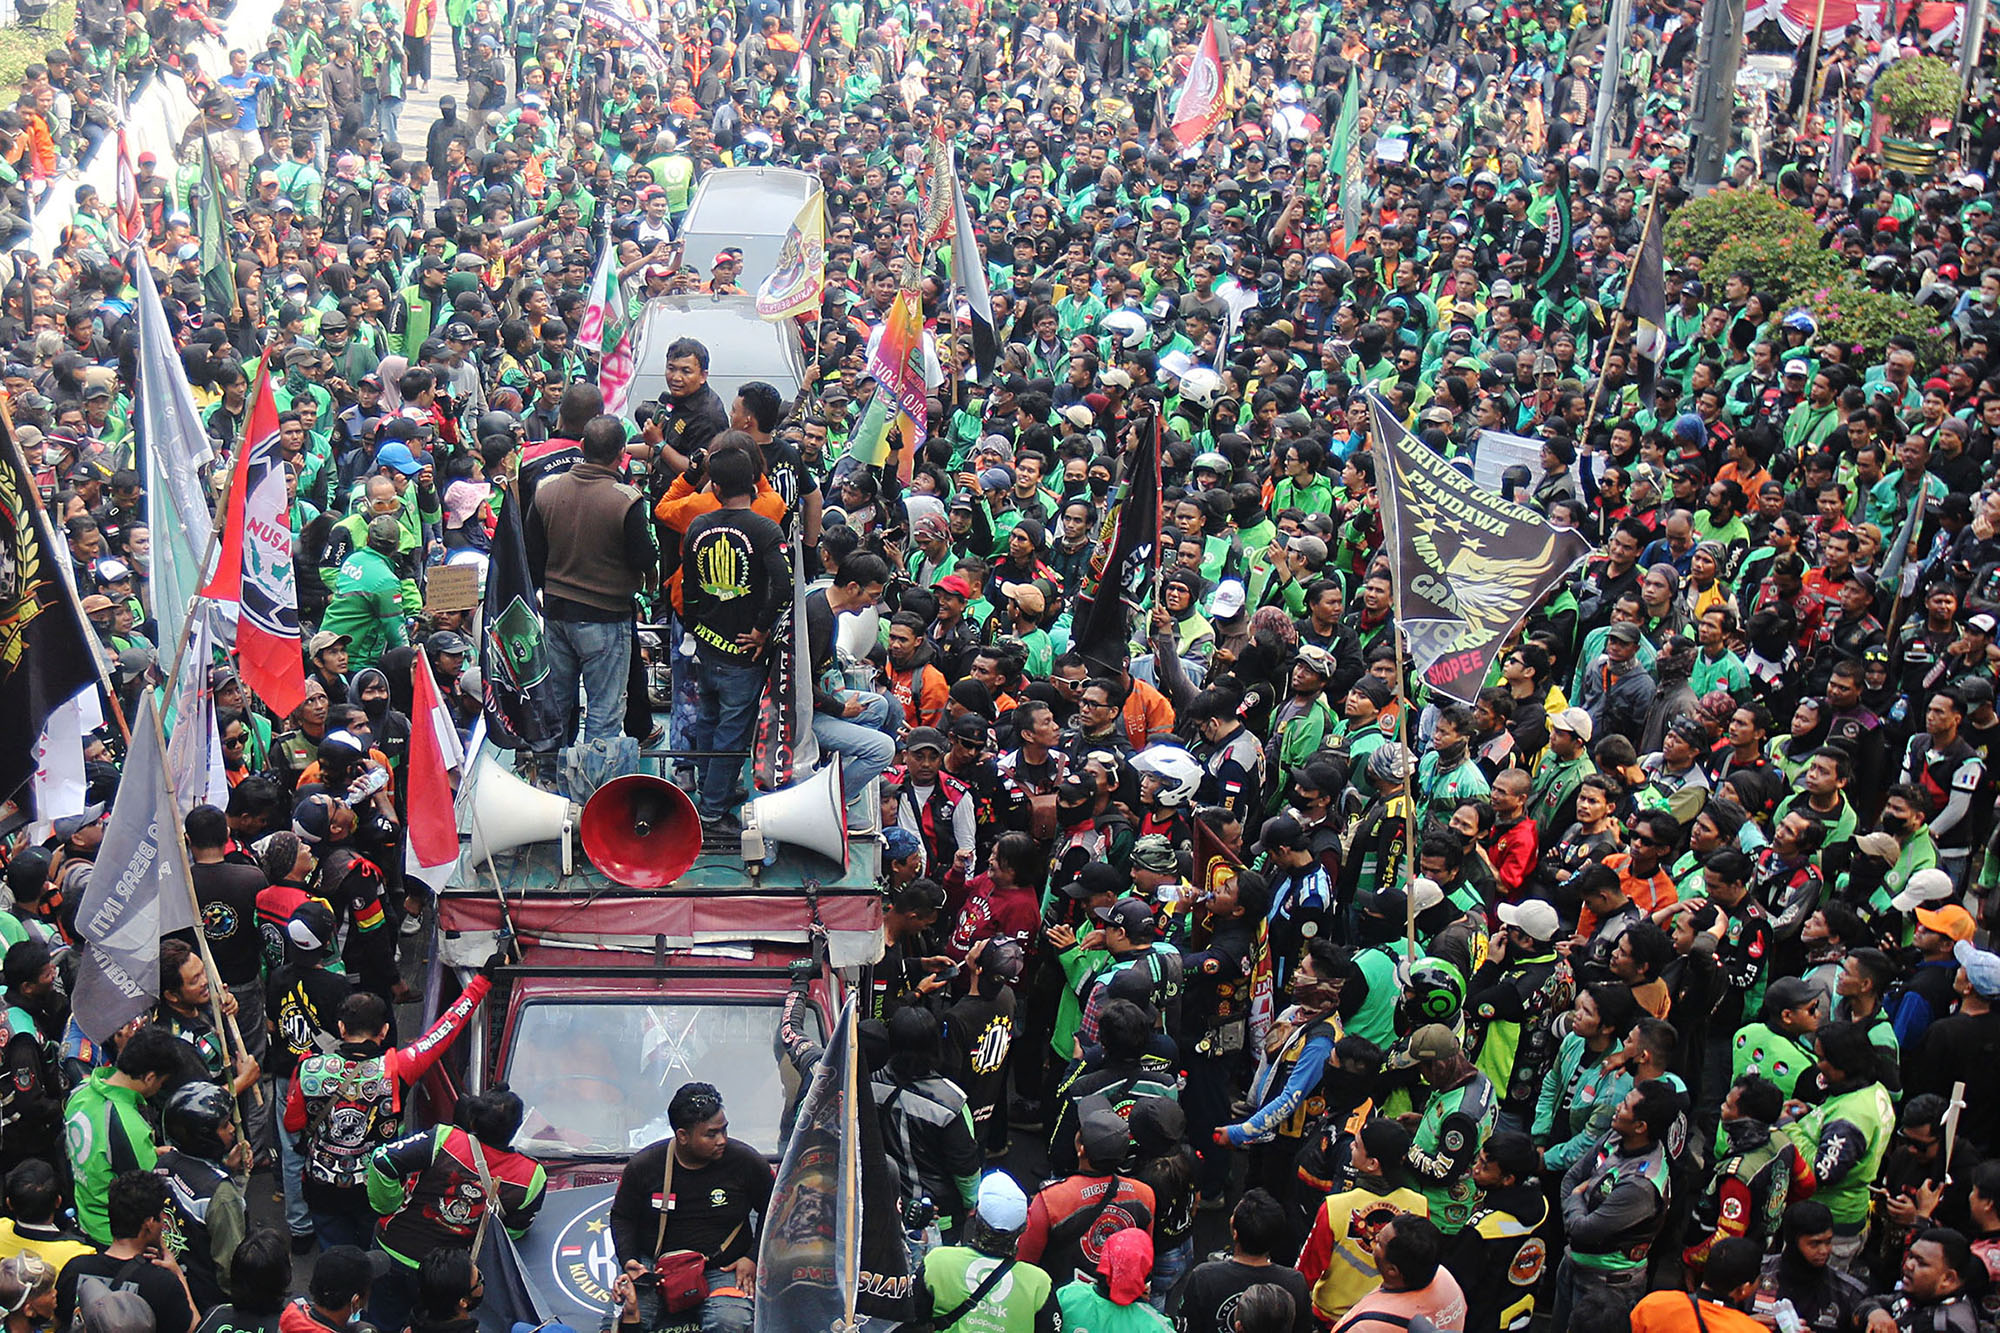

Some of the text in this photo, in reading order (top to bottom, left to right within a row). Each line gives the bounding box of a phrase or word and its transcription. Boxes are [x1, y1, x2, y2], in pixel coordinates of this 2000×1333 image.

[1397, 434, 1473, 494] DRIVER
[1470, 490, 1541, 526] ONLINE
[1406, 470, 1510, 537] PANDAWA
[246, 517, 294, 558] NUSA
[694, 623, 747, 655] PATRIO
[1428, 650, 1484, 686] SHOPEE
[970, 1300, 1008, 1319] ojek
